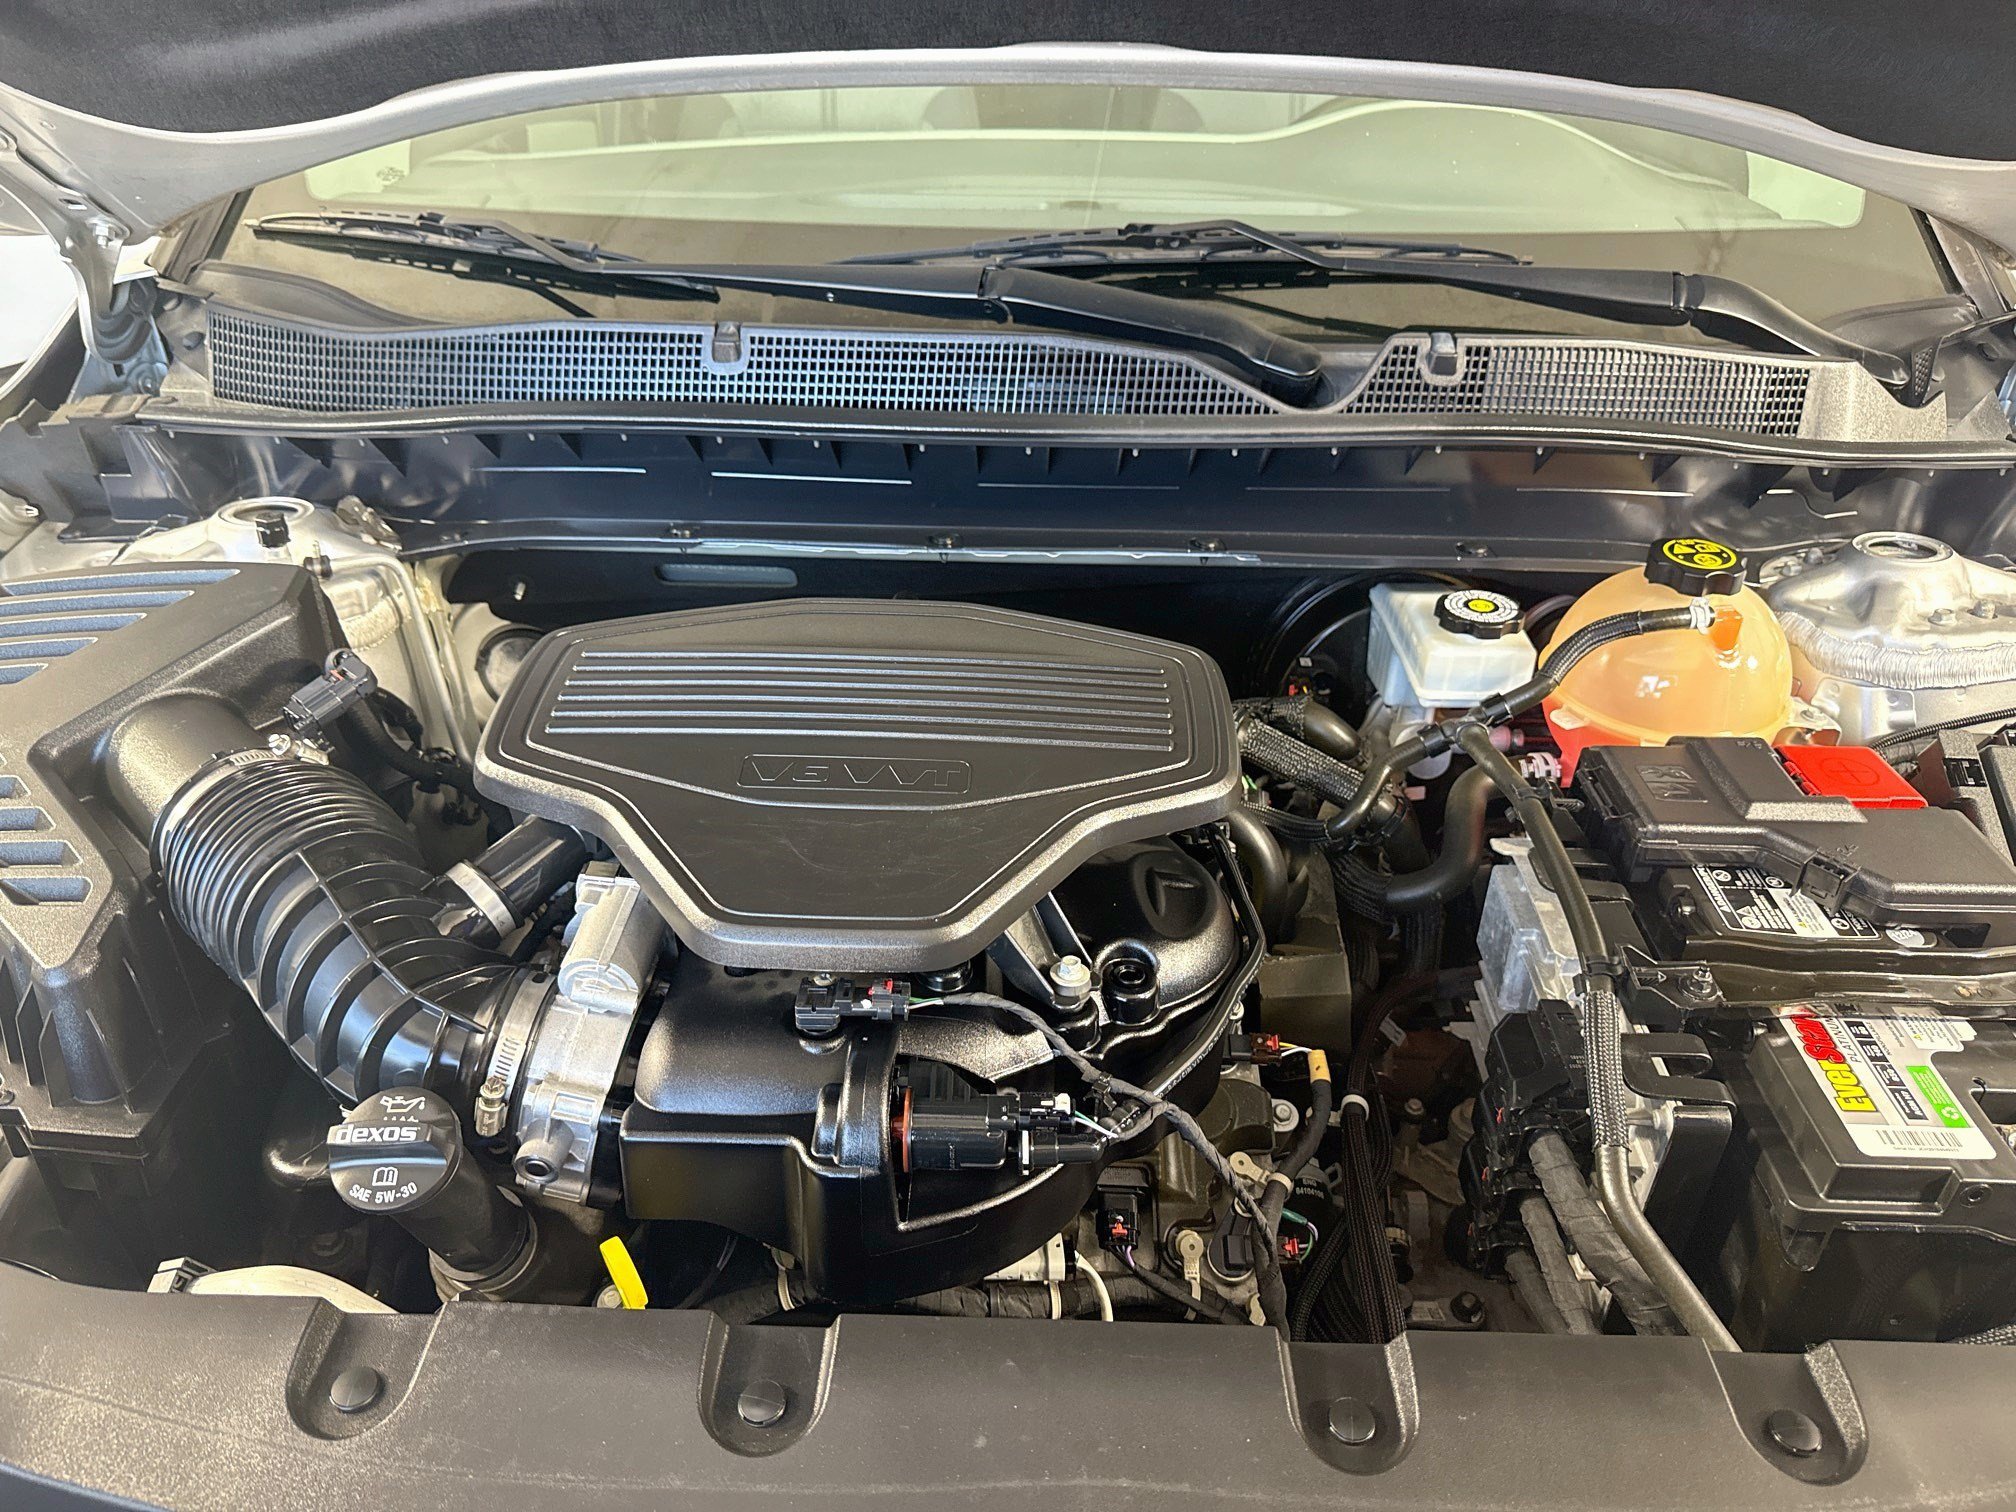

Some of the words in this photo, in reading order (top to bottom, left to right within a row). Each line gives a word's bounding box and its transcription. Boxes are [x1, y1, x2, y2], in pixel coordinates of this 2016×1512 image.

[751, 760, 830, 783] V6
[843, 763, 961, 787] VVT
[335, 1124, 418, 1144] dexos
[349, 1184, 372, 1203] SAE
[374, 1182, 418, 1204] 5W-30
